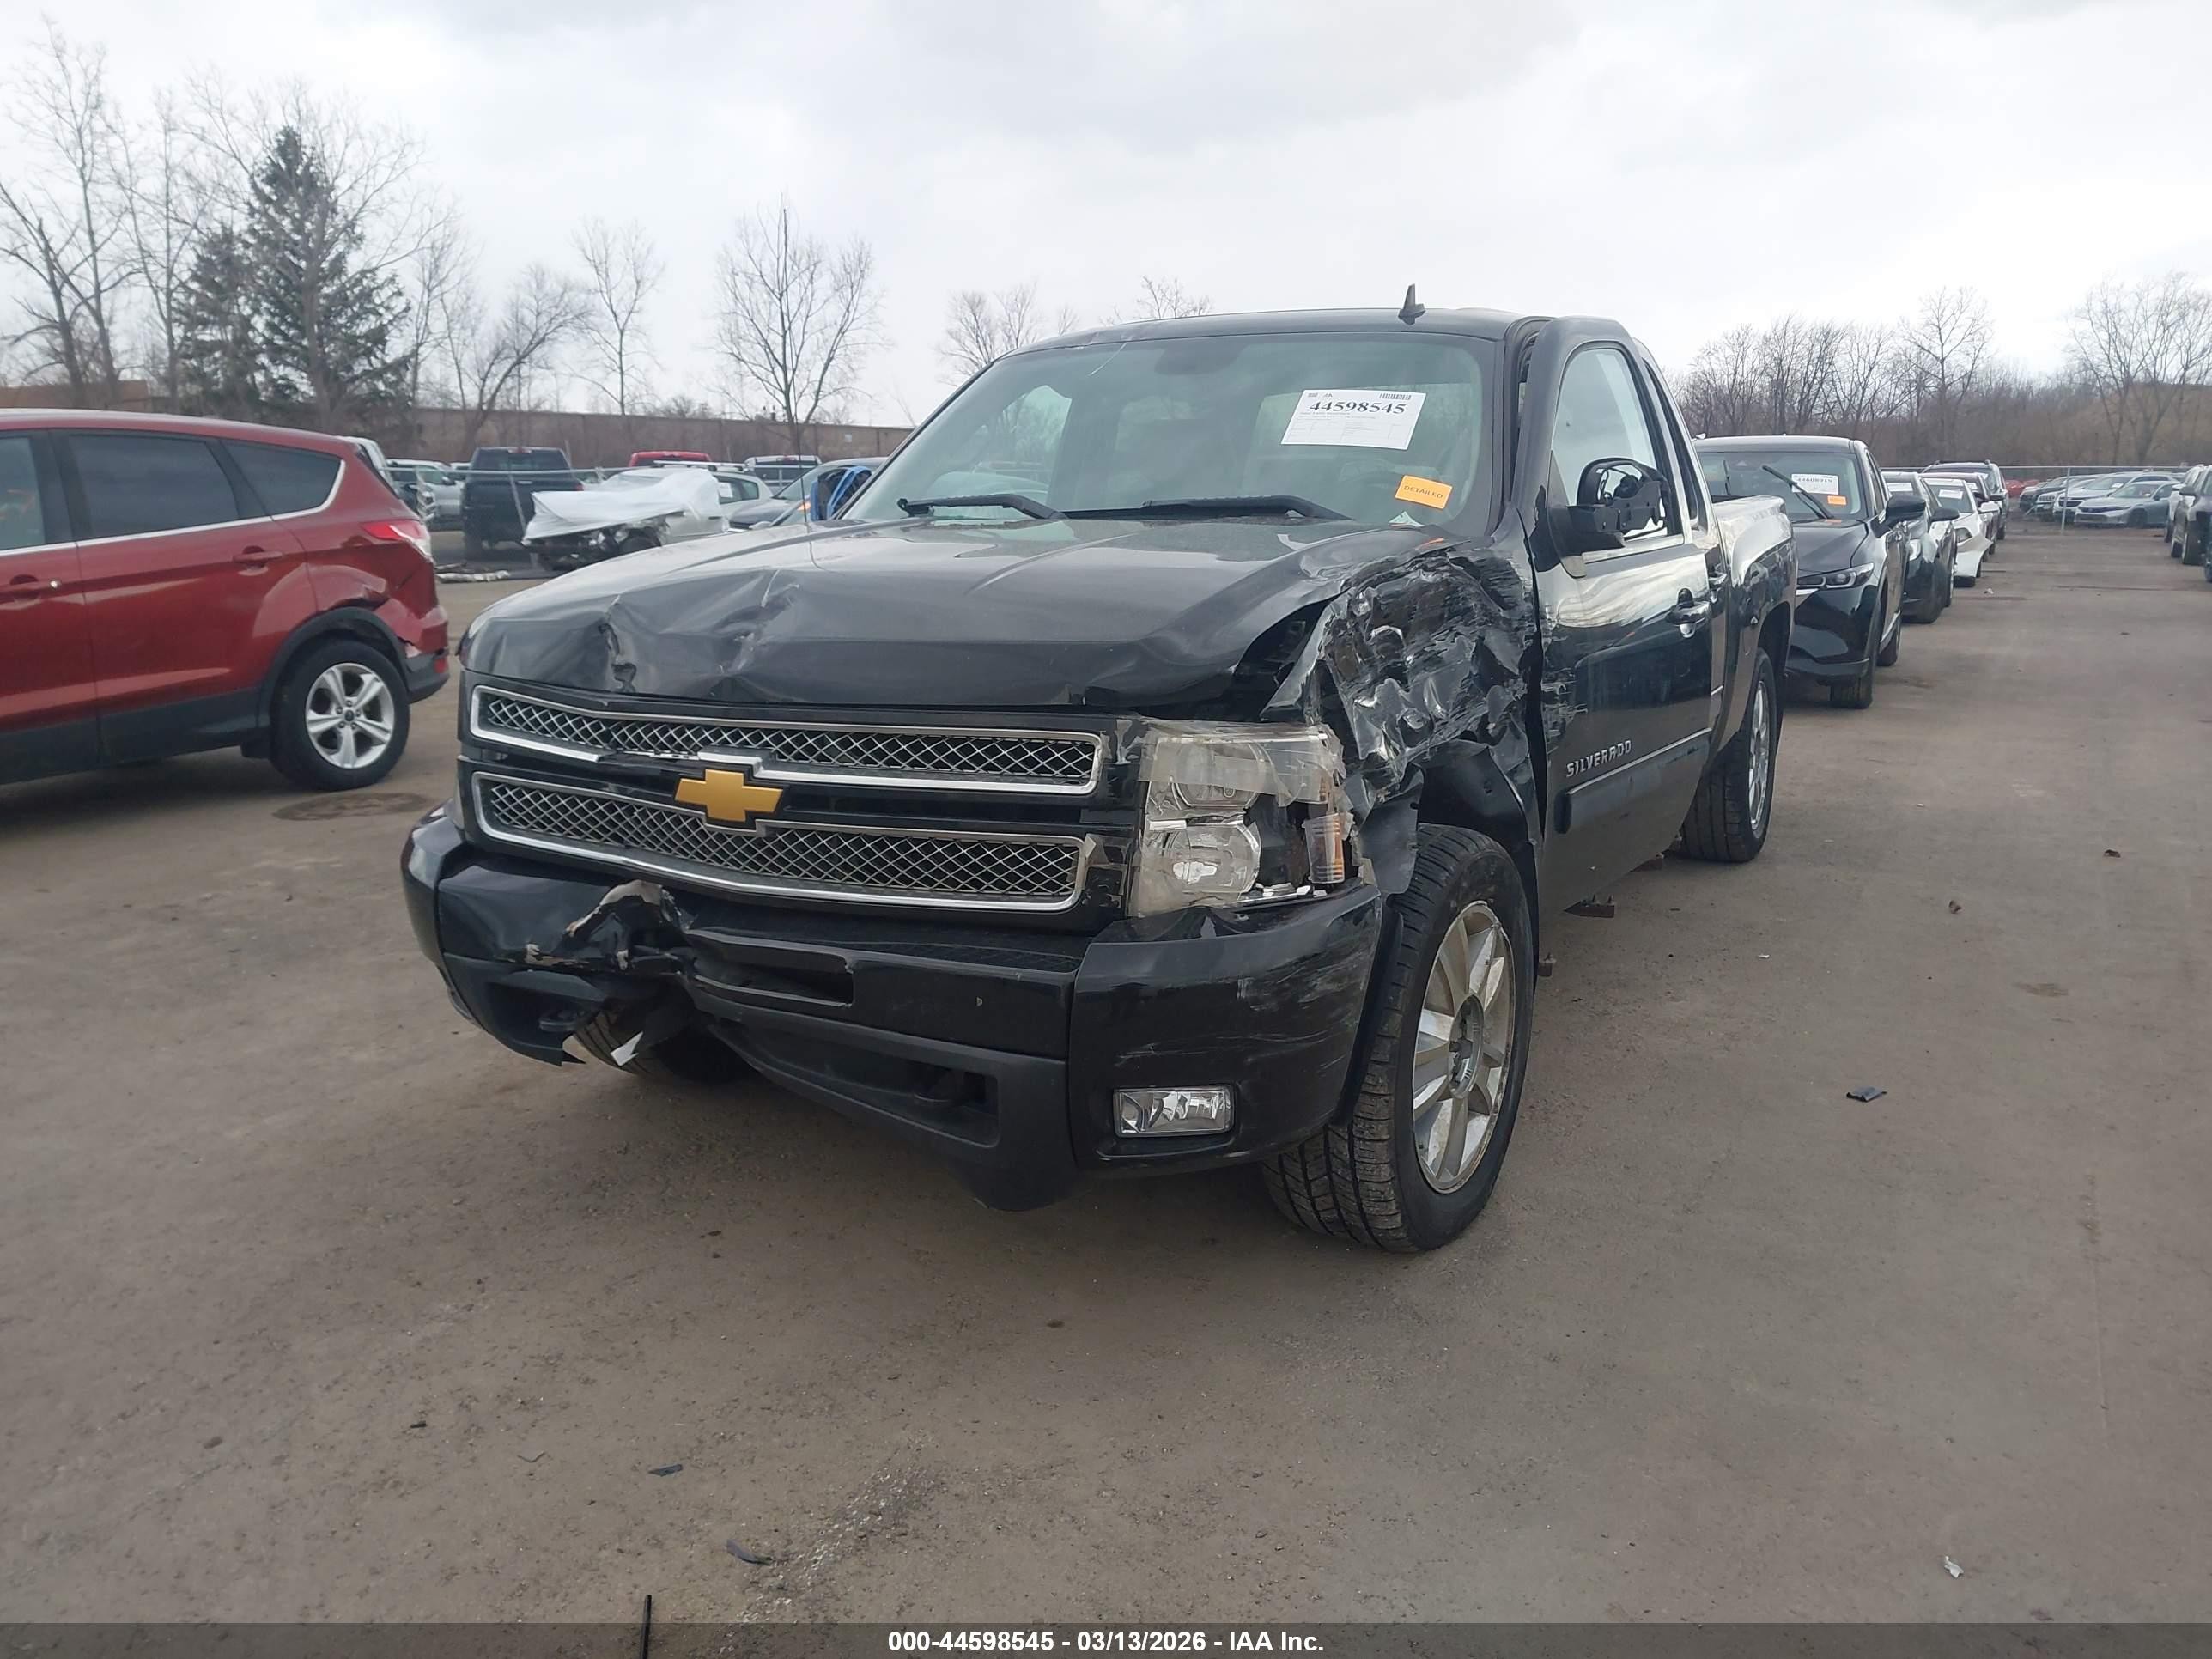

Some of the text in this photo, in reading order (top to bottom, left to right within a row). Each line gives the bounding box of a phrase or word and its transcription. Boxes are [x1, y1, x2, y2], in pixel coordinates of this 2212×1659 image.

[1309, 401, 1407, 415] 44598545
[1403, 484, 1443, 499] DETAILED
[1566, 740, 1632, 778] SILVERADO
